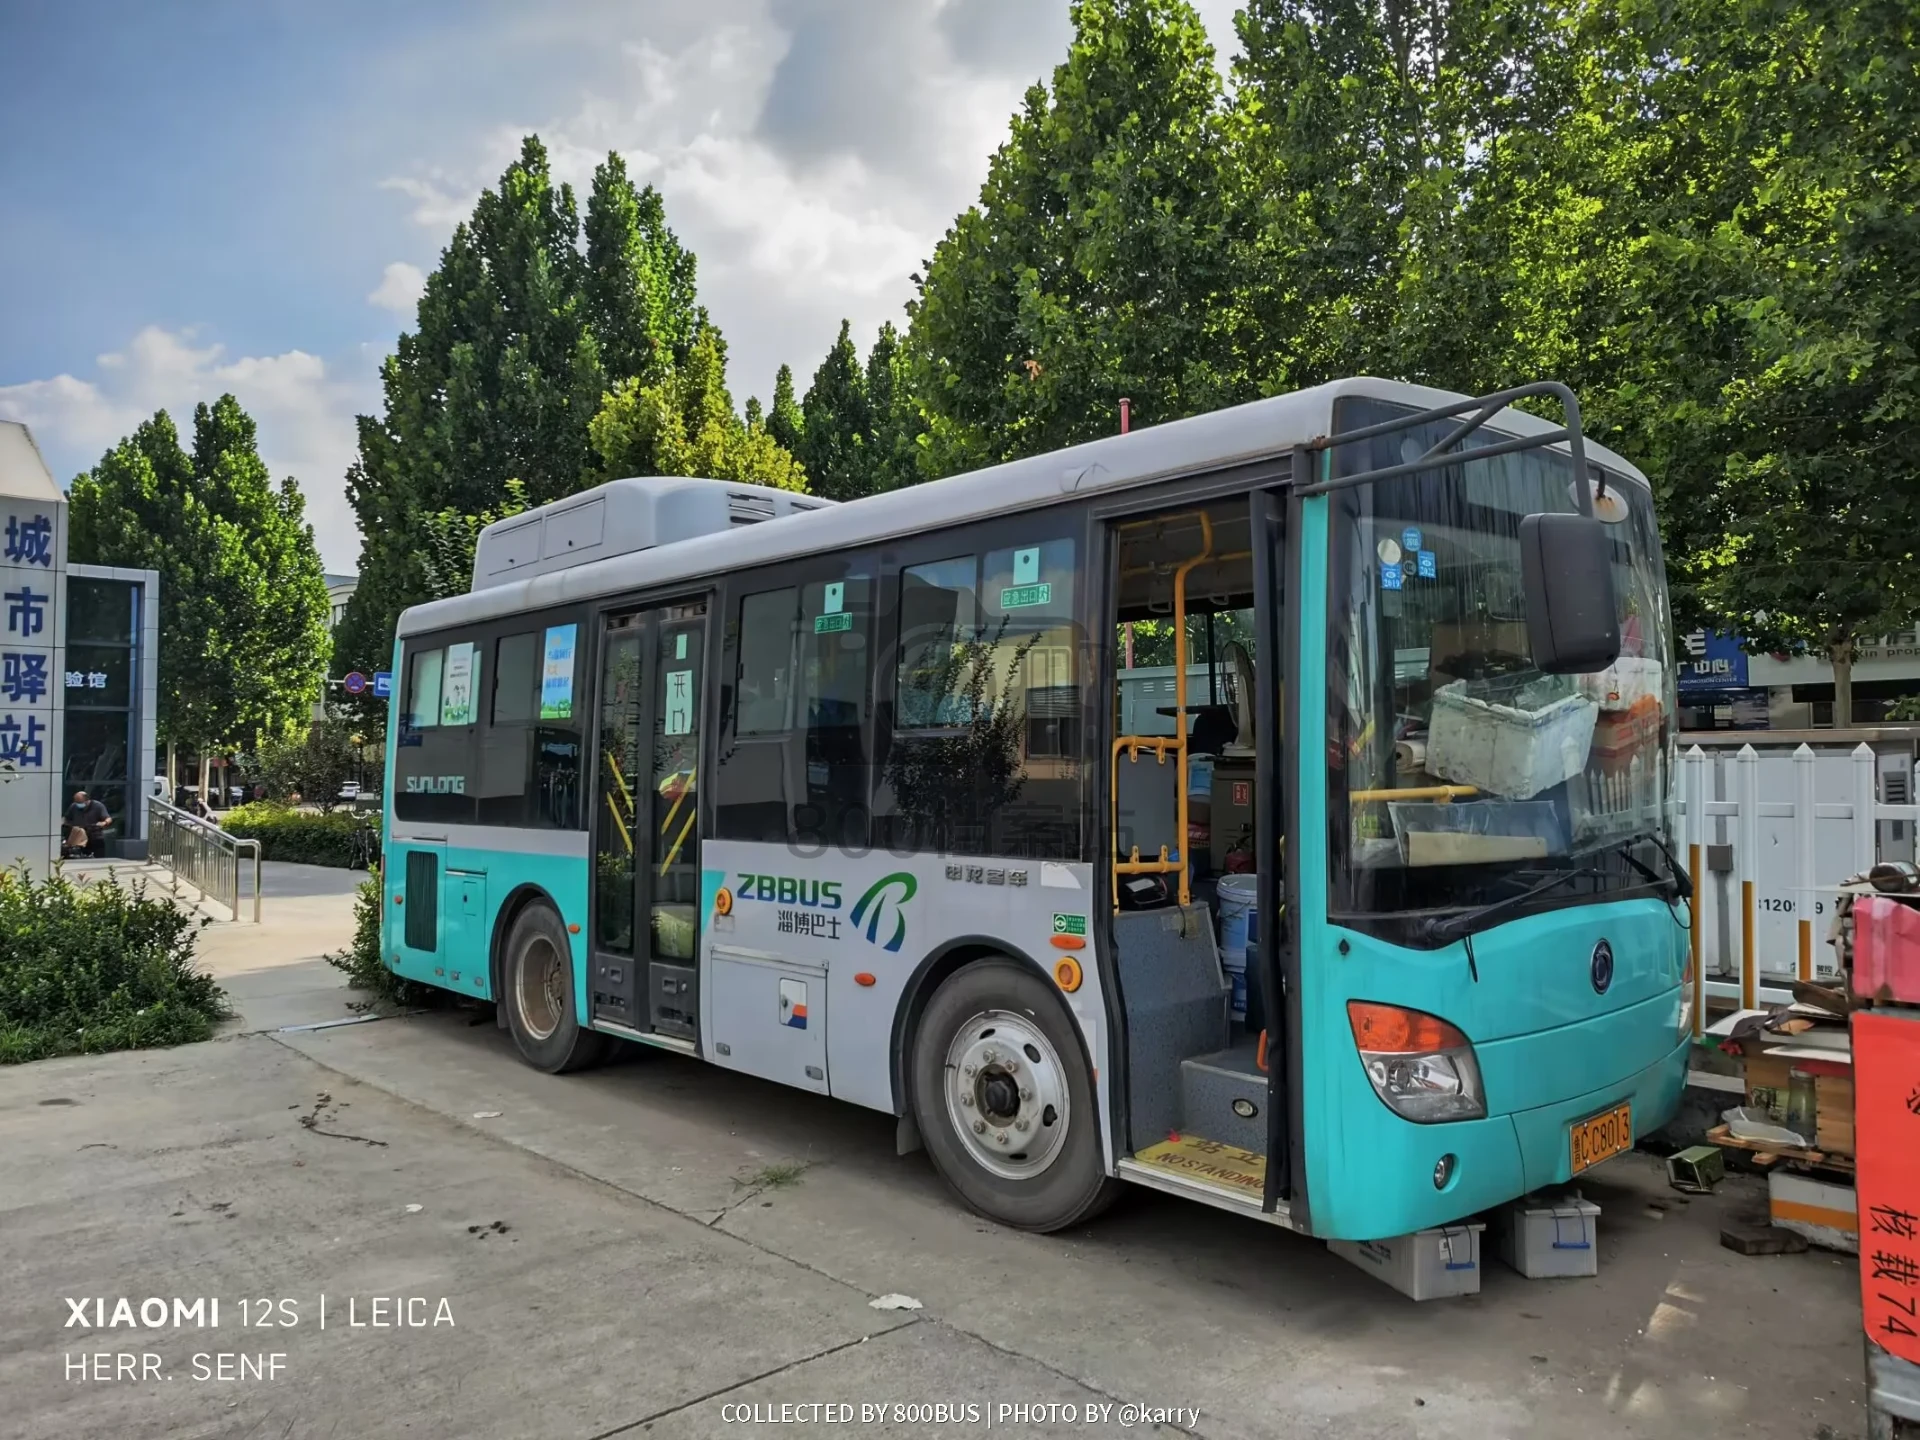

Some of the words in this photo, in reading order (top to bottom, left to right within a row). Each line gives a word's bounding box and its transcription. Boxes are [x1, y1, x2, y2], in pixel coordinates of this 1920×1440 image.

[1003, 588, 1036, 606] 应急出口
[0, 514, 52, 767] 城市驿站
[406, 776, 465, 794] SUNLONG
[737, 873, 842, 909] ZBBUS
[777, 910, 841, 940] 淄博巴士
